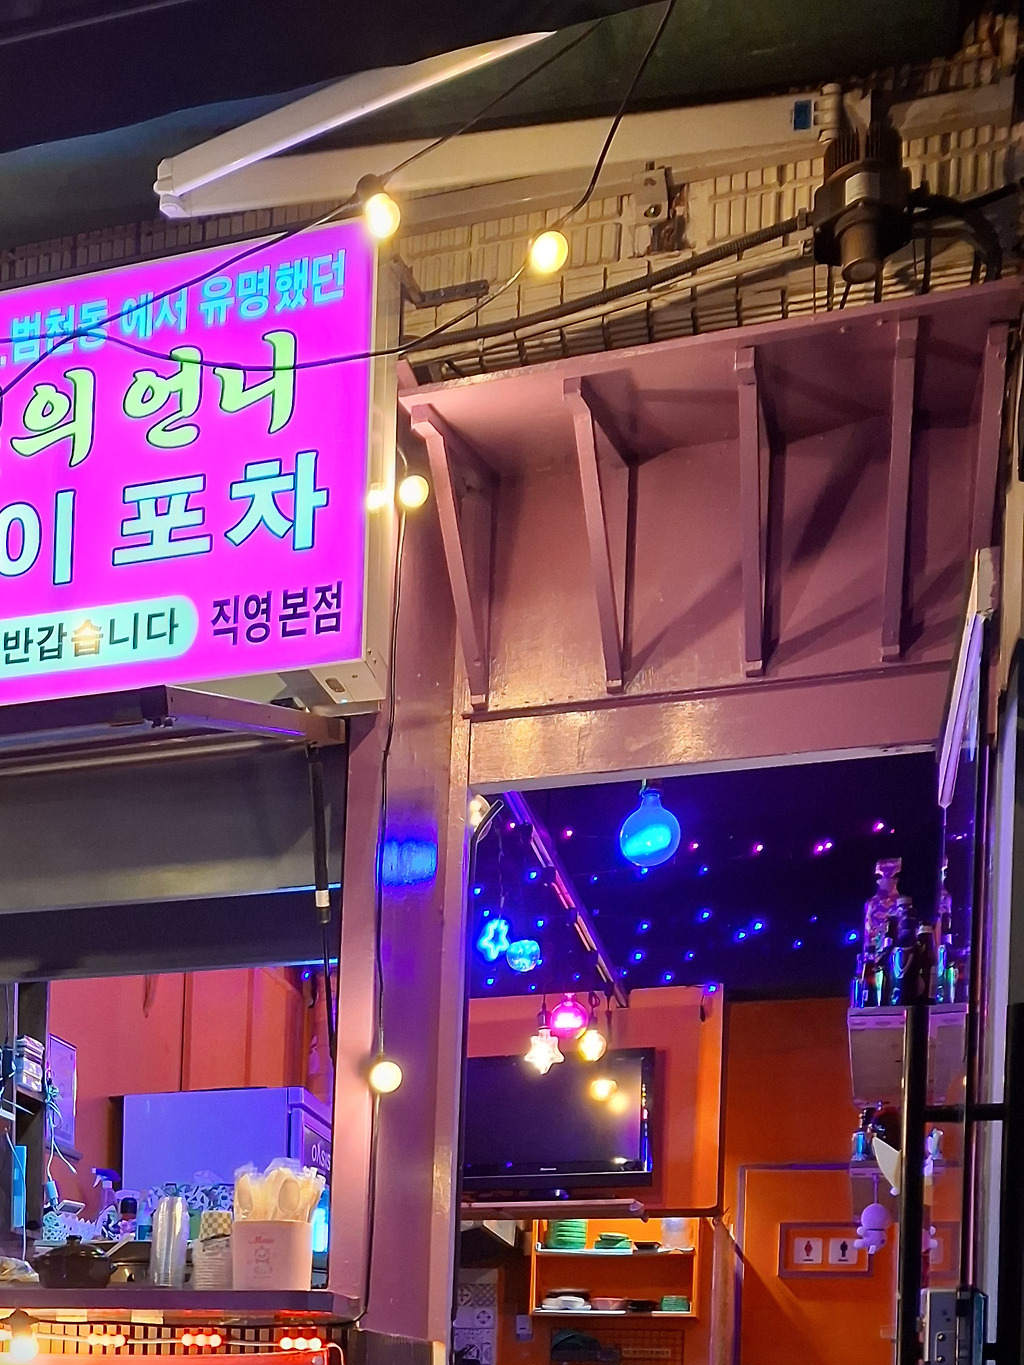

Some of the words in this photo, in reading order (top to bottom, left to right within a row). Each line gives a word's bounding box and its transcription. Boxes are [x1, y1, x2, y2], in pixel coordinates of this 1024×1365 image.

[121, 288, 188, 339] 에서
[200, 248, 347, 325] 유명했던
[123, 330, 297, 449] 언니
[112, 450, 329, 567] 포차
[2, 607, 180, 665] 반갑습니다
